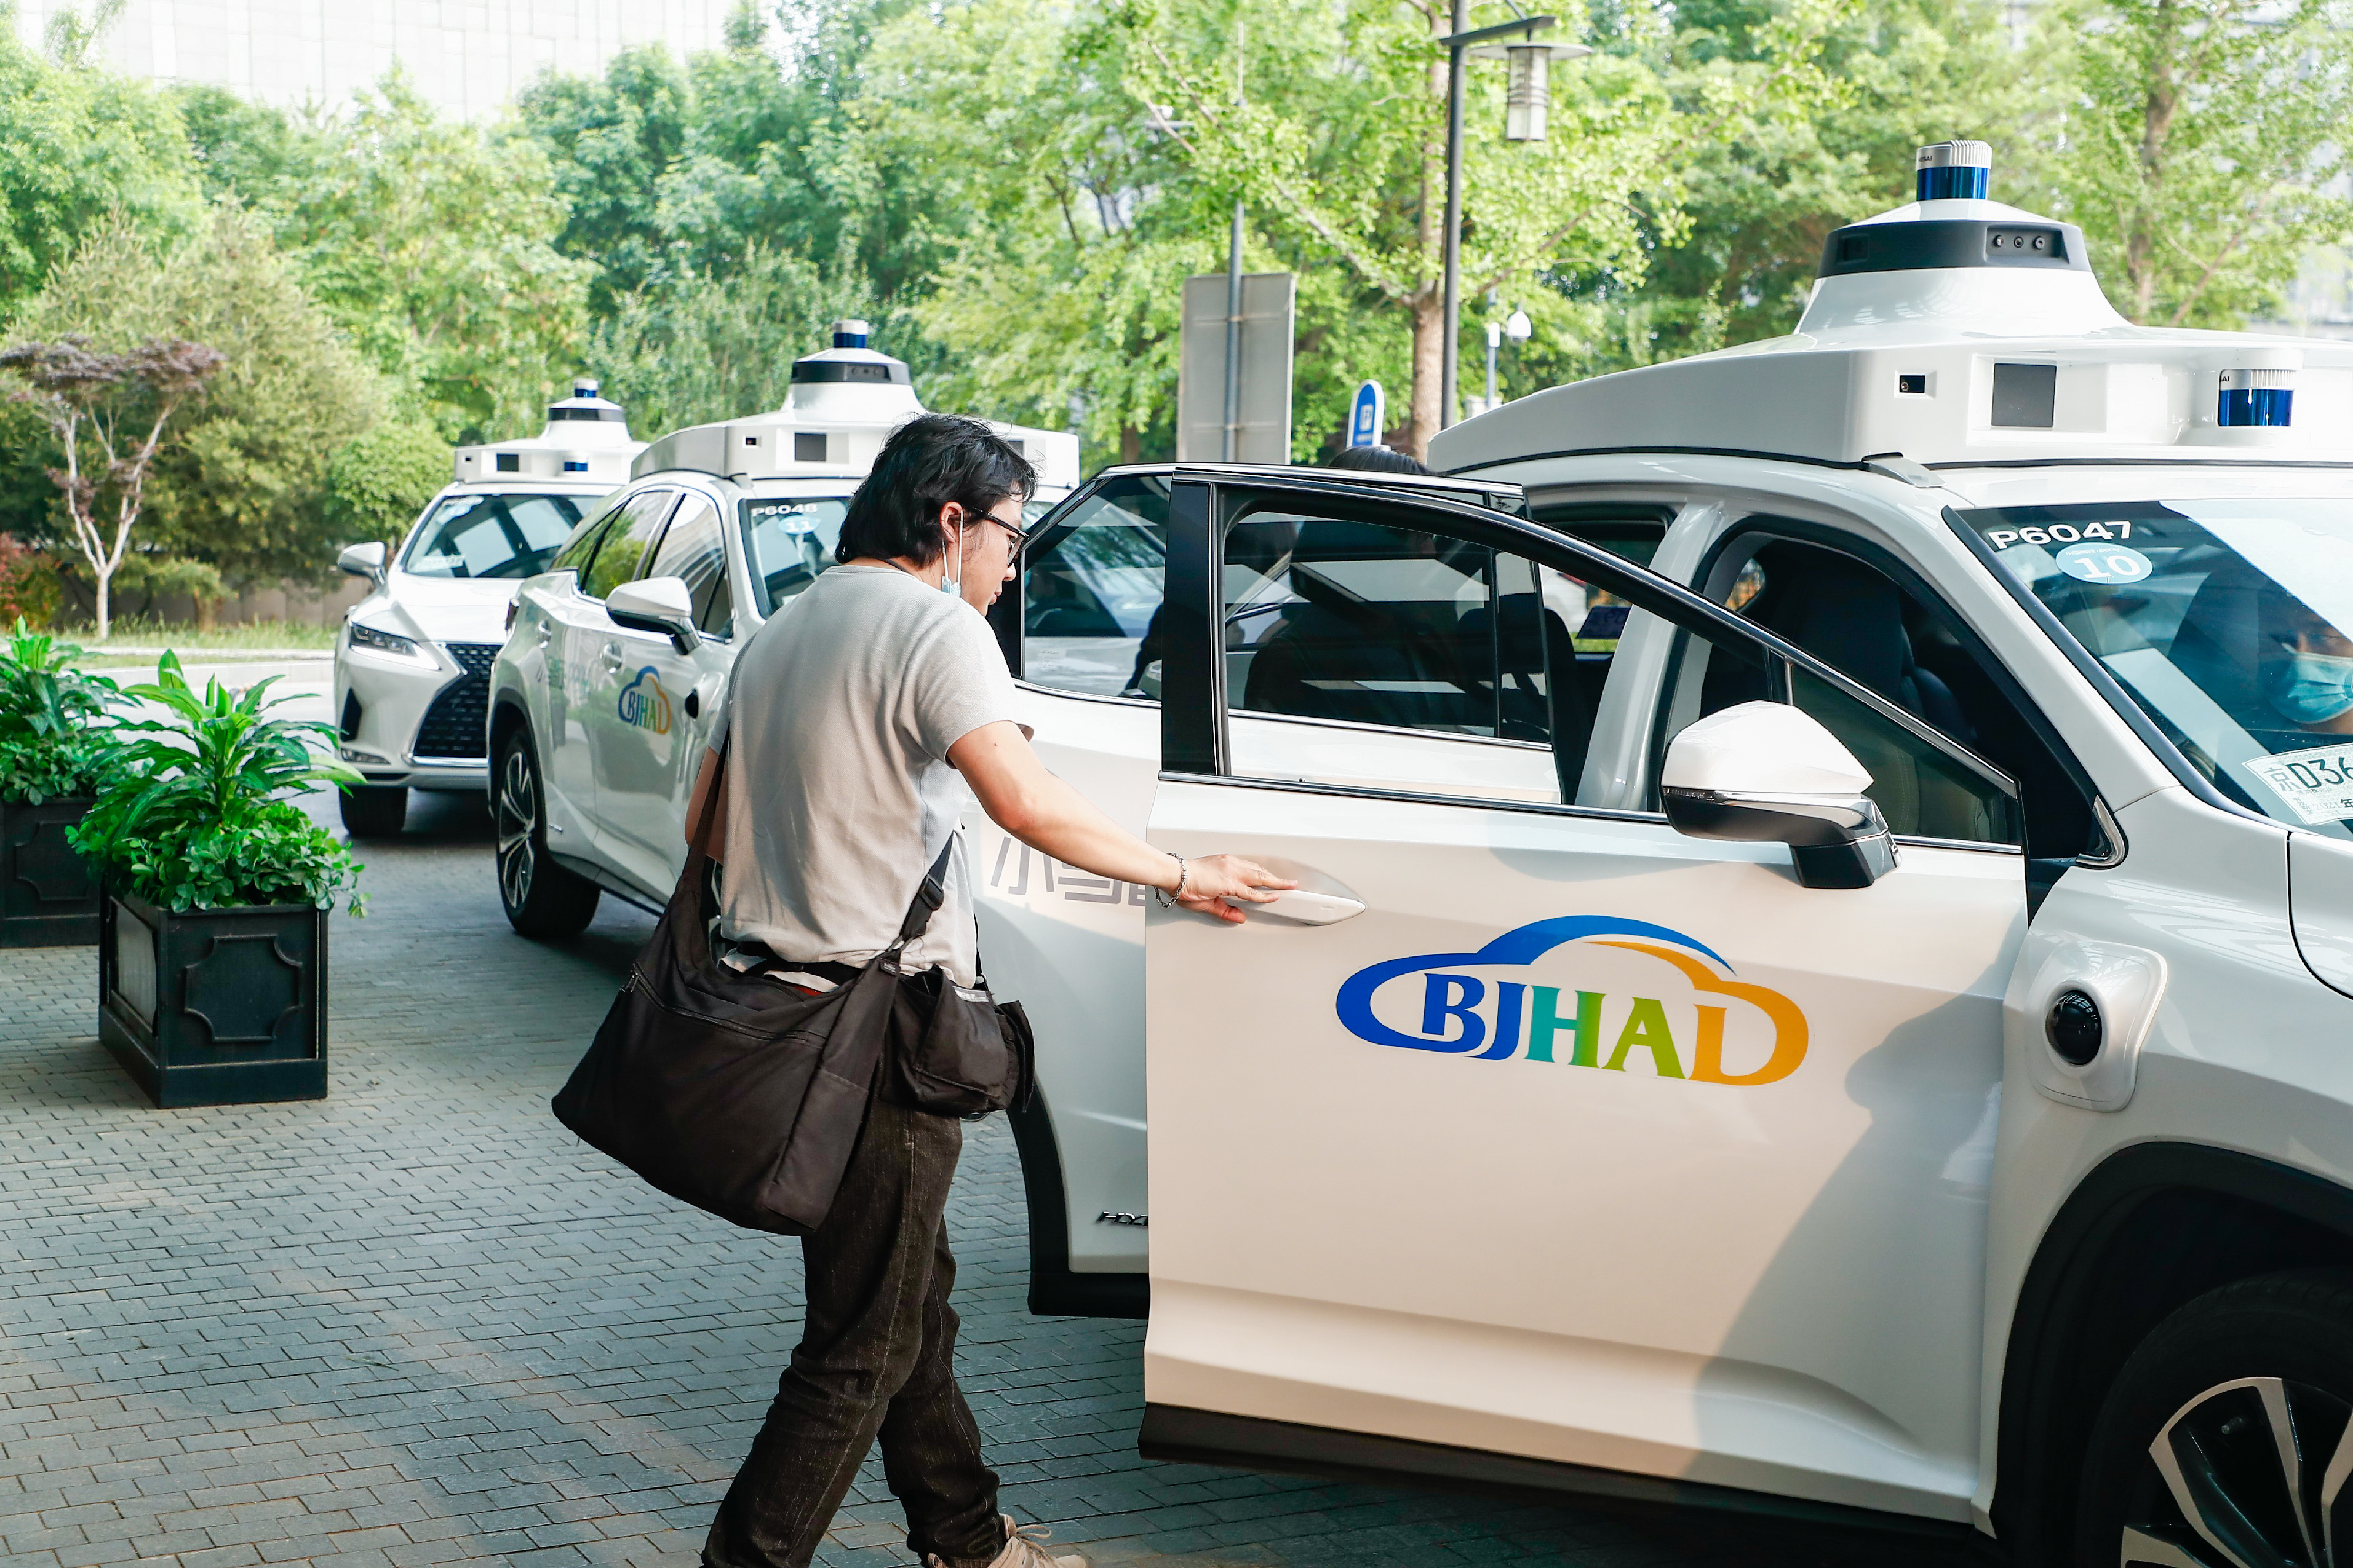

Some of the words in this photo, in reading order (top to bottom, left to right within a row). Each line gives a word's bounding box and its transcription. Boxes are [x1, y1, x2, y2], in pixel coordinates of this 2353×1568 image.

[785, 520, 815, 532] 11
[1988, 521, 2132, 549] P6047
[2074, 555, 2141, 579] 10
[628, 690, 671, 735] BJHAD
[1422, 973, 1809, 1086] BJHAD
